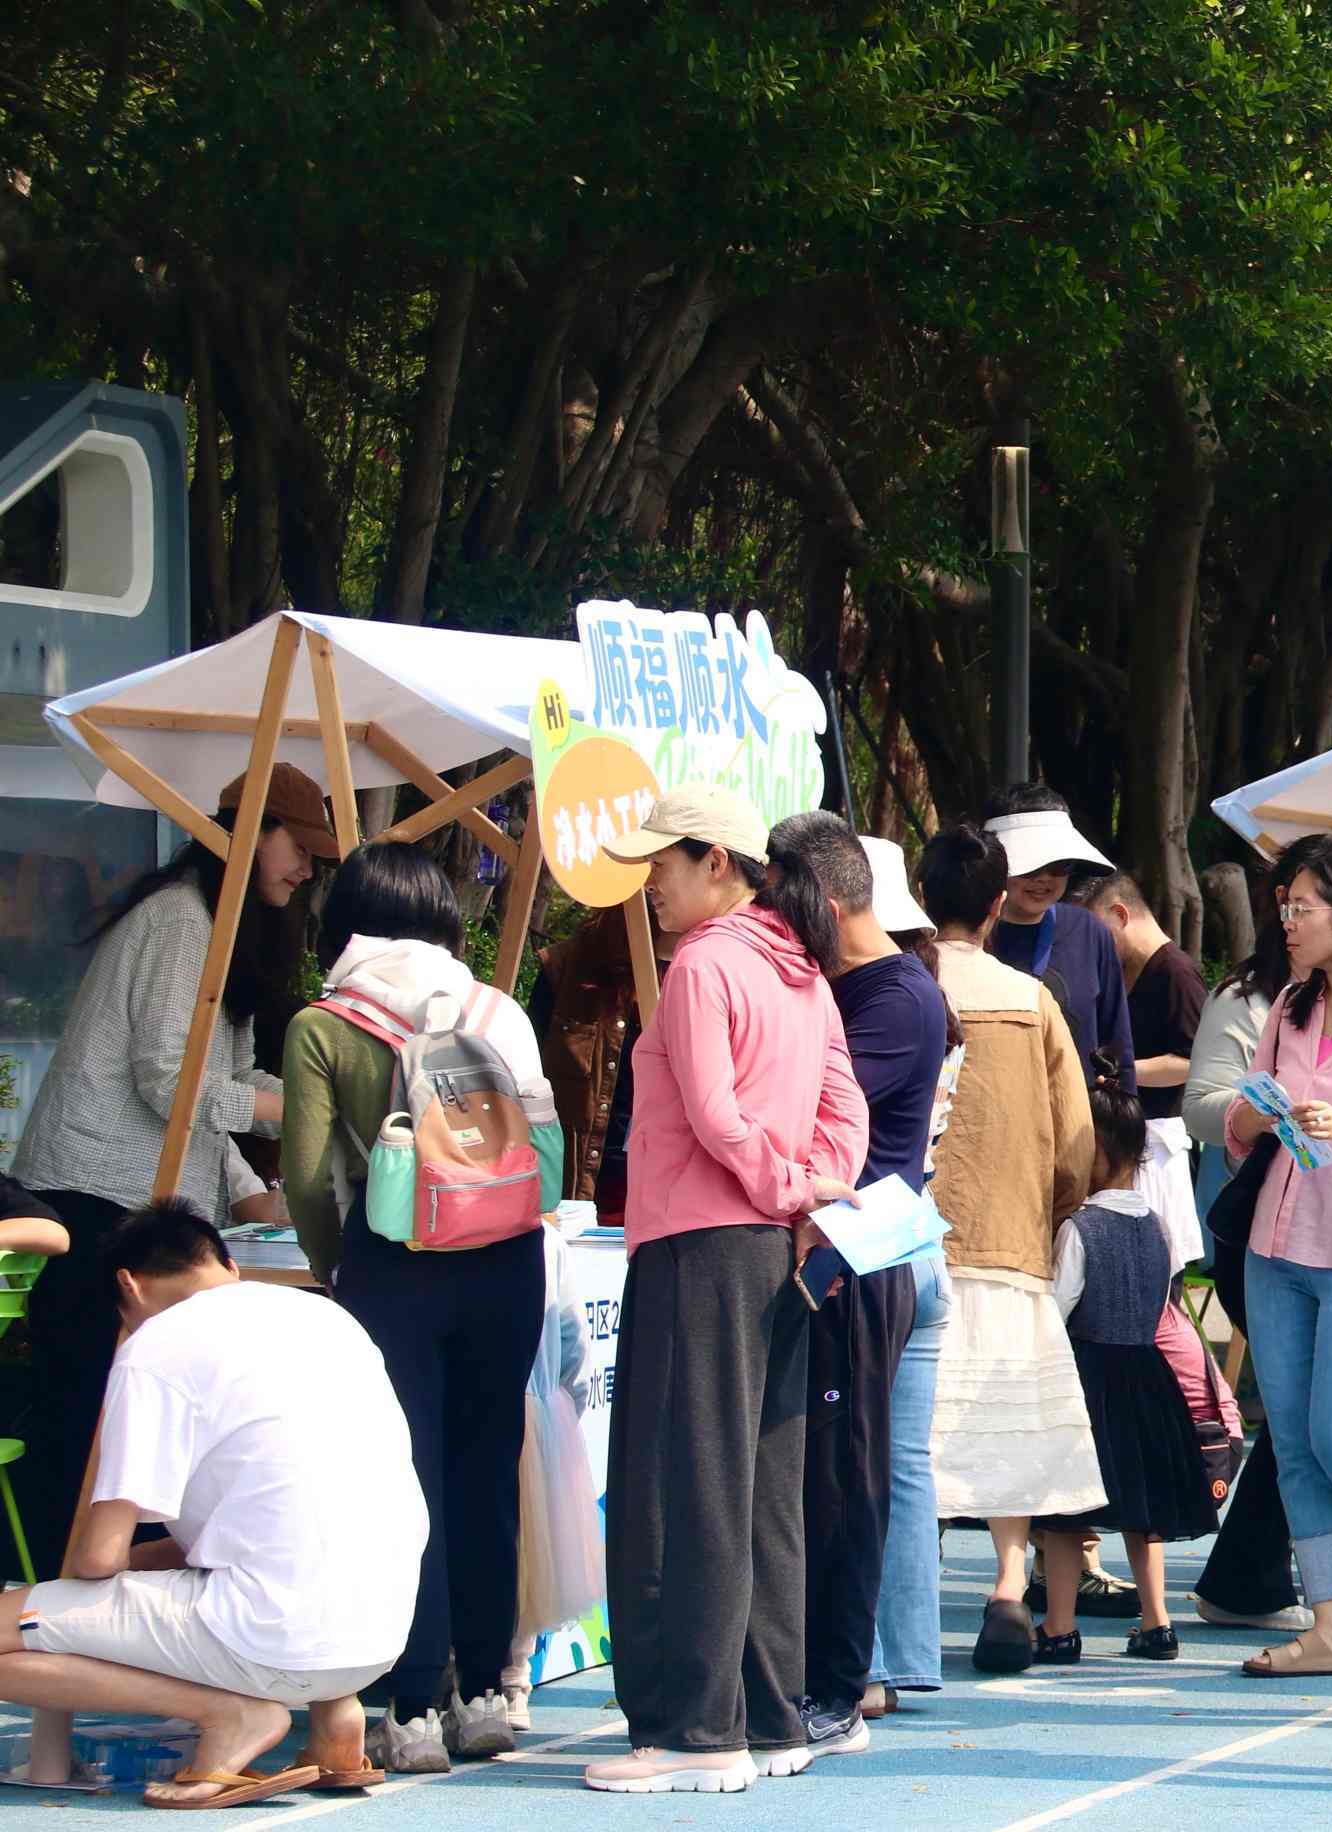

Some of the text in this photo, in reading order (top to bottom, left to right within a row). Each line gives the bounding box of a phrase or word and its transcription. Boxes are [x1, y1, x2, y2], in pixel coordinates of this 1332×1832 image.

[543, 693, 565, 731] Hi
[588, 619, 768, 745] 顺福顺水
